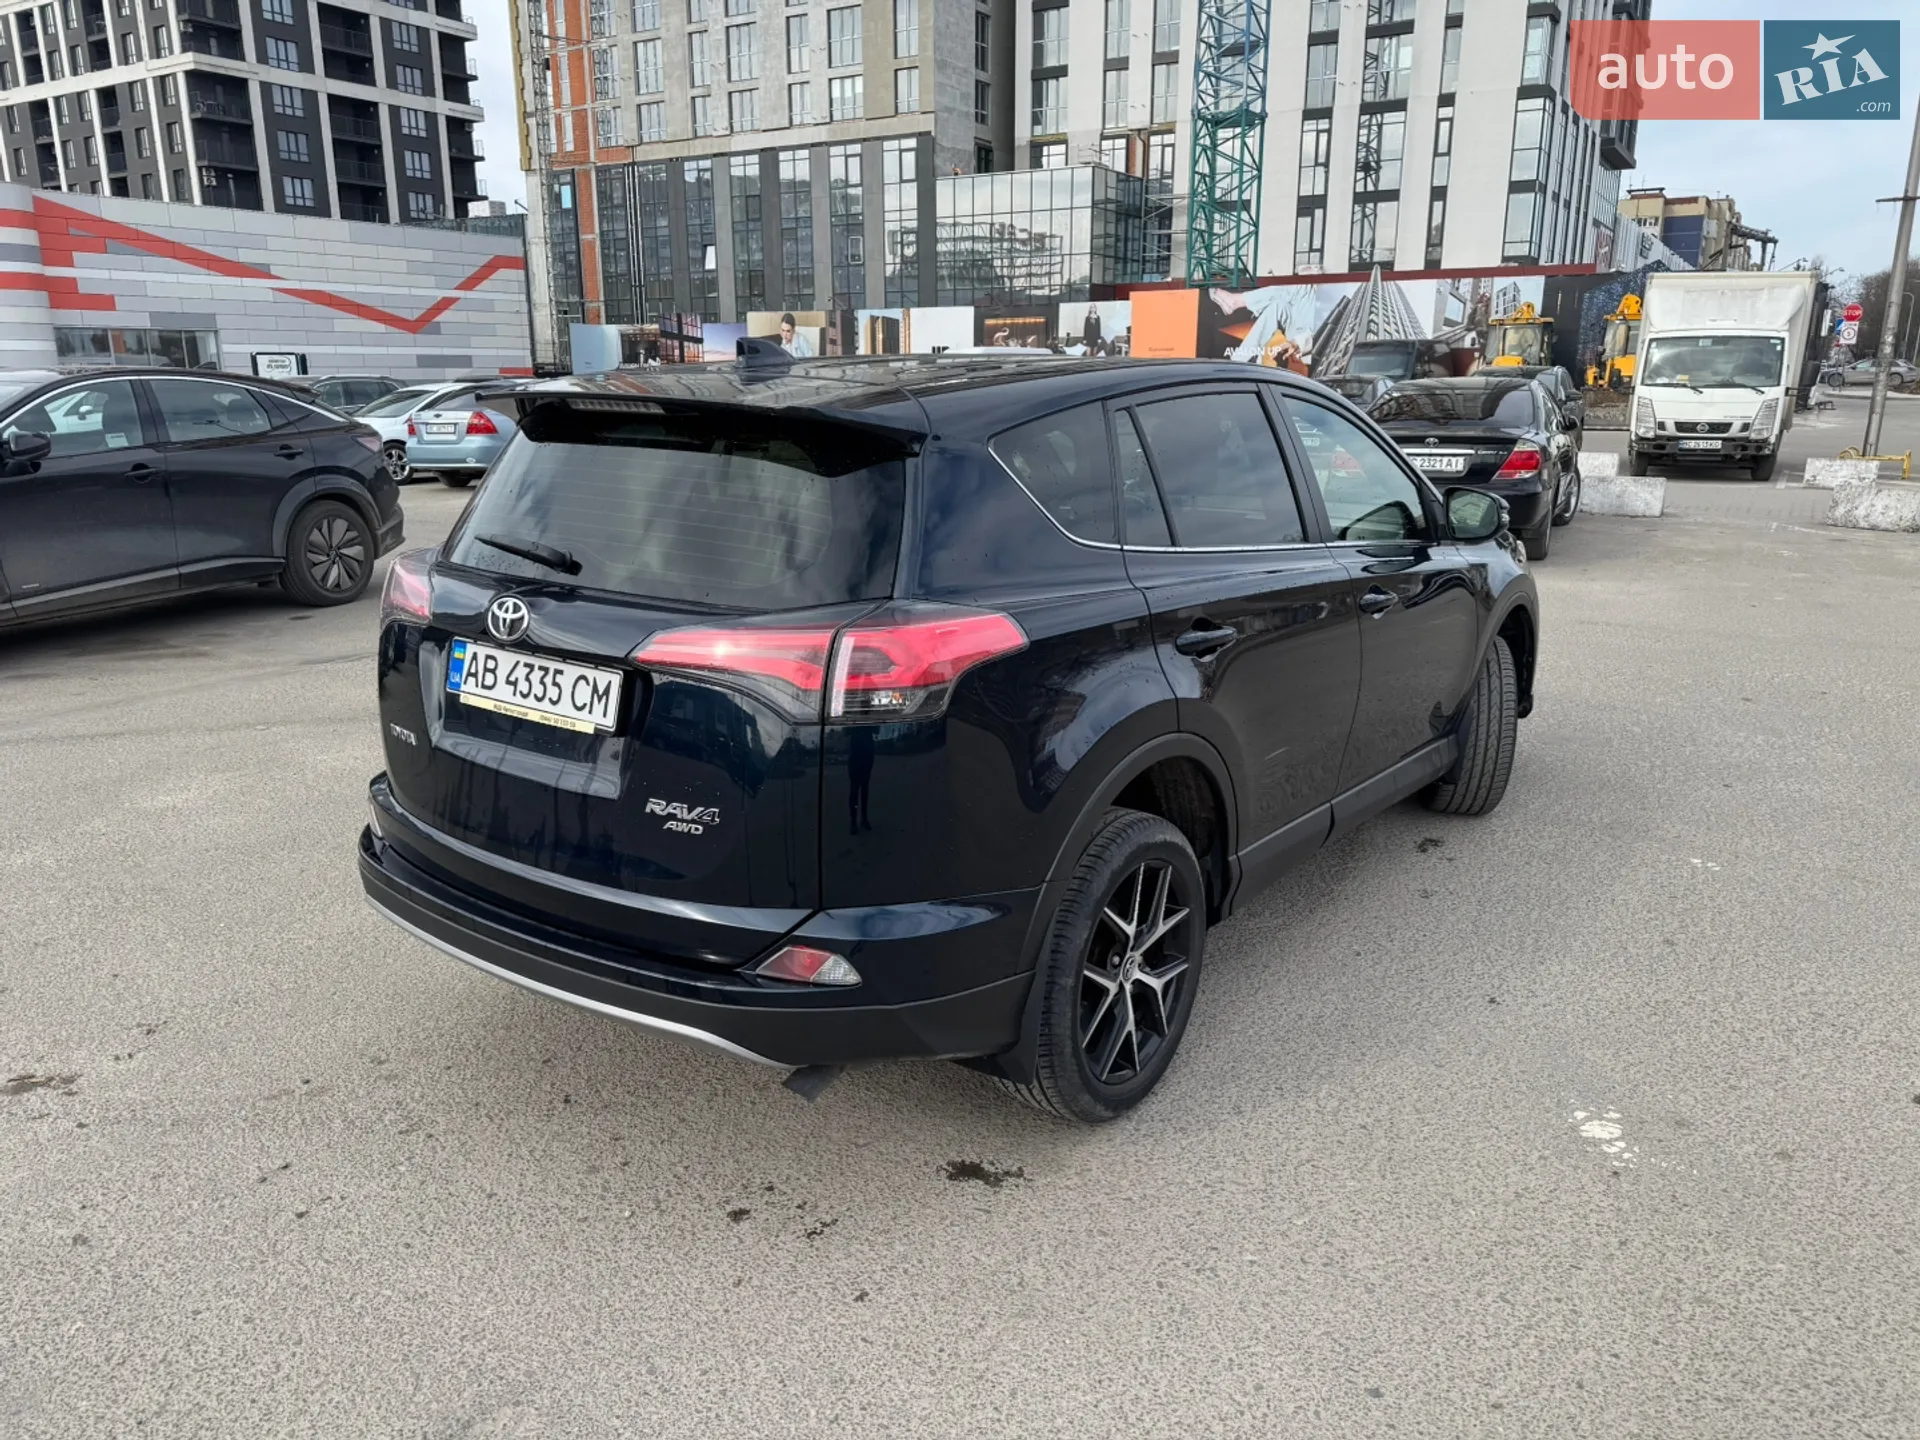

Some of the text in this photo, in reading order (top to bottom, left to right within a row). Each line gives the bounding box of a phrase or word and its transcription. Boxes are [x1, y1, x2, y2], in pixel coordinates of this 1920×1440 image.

[1224, 346, 1282, 356] AVALON UP
[1419, 458, 1443, 468] 2321
[450, 671, 461, 683] UA
[463, 651, 612, 718] AB 4335 CM
[645, 797, 720, 825] RAV4
[663, 820, 704, 835] AWD
